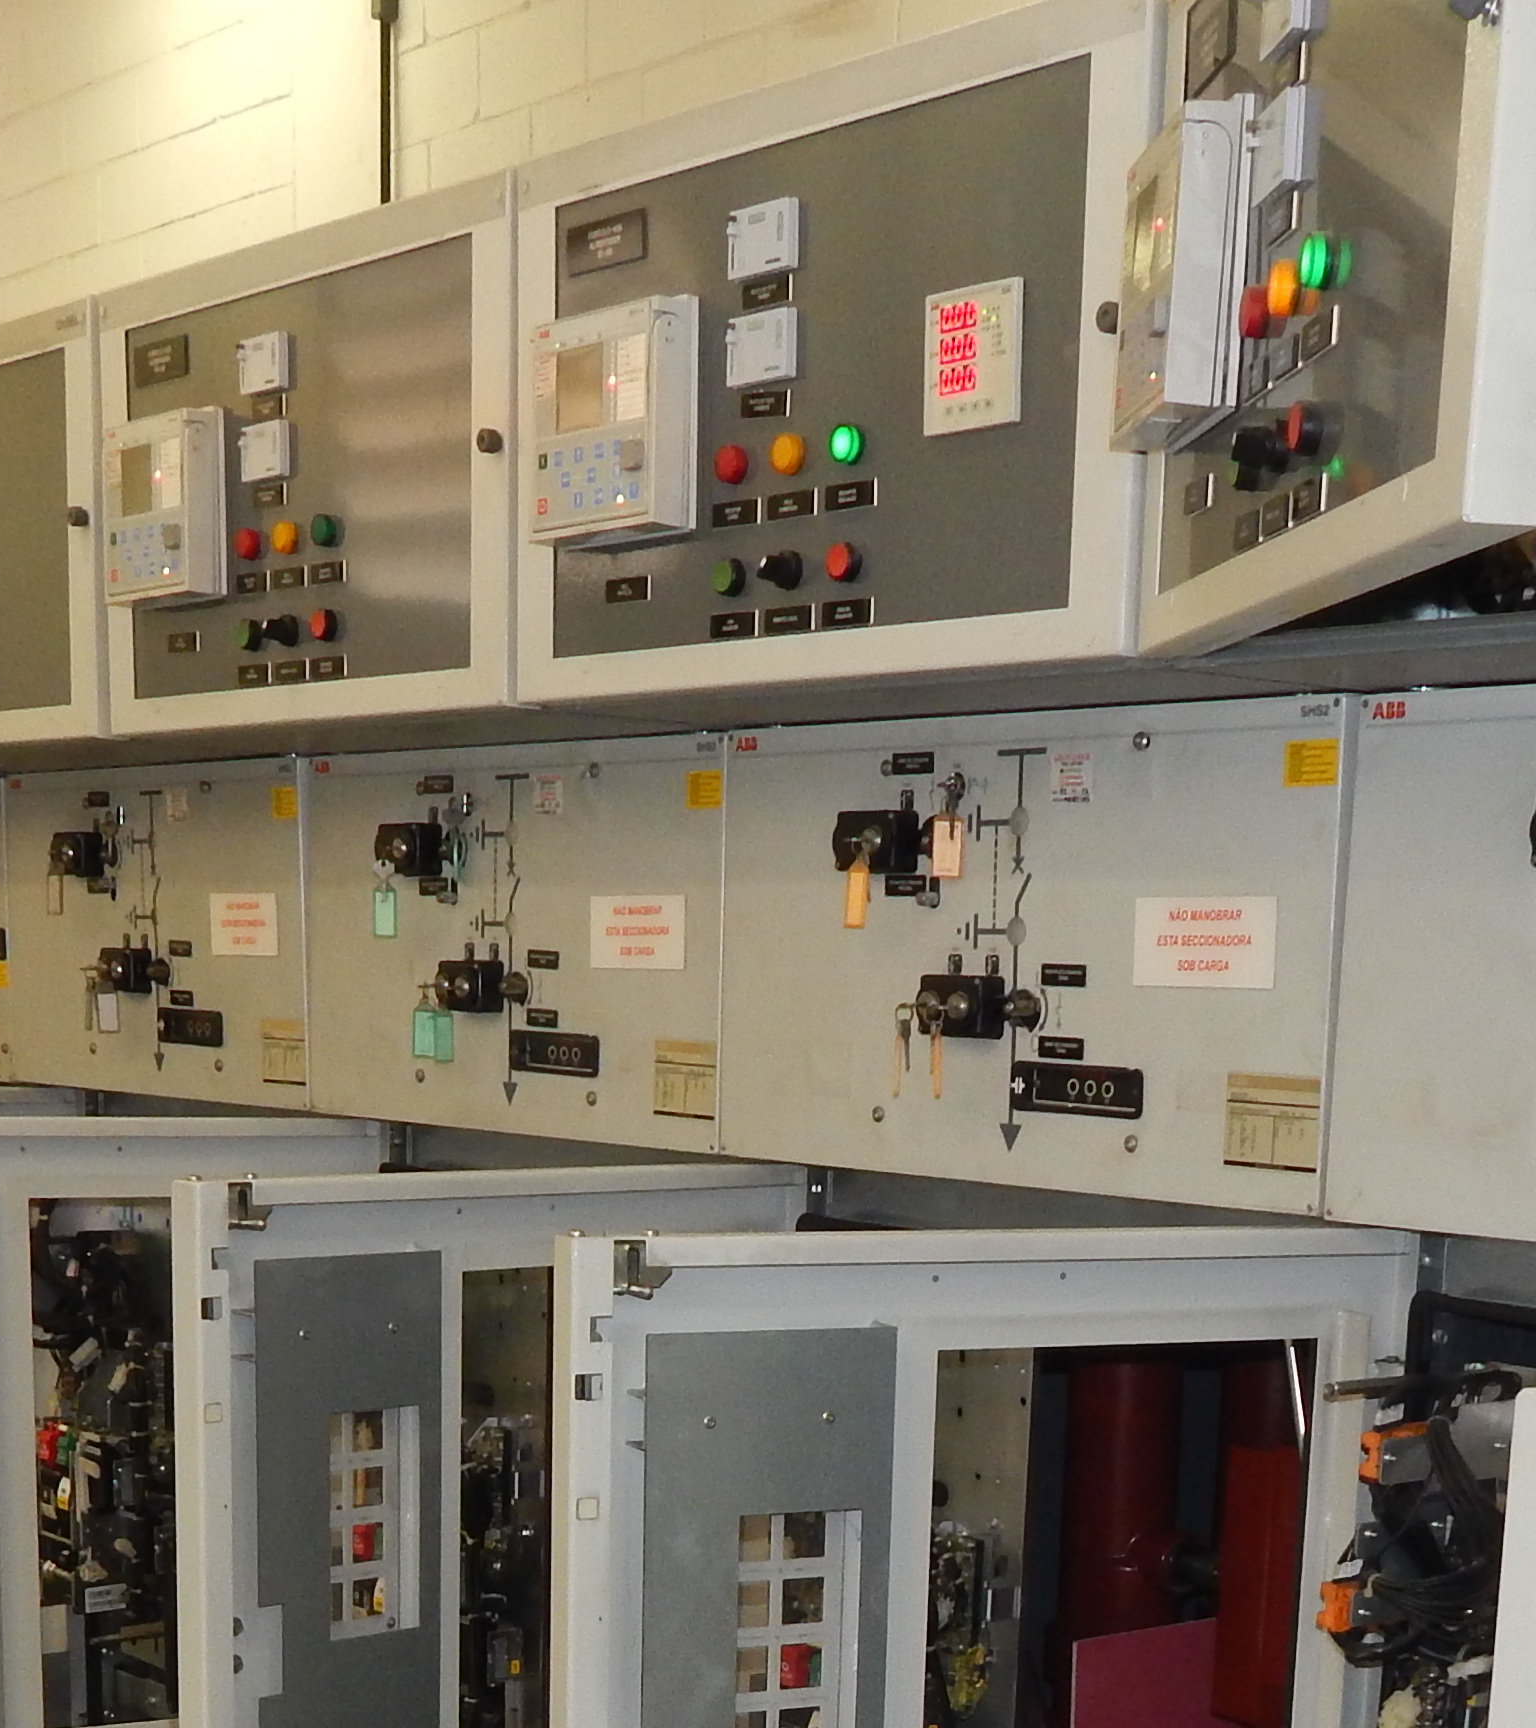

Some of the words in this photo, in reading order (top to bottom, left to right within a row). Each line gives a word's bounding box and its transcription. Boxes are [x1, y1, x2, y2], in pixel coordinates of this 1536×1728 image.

[1372, 701, 1406, 720] ABB
[1190, 908, 1242, 921] MANOBRAR
[1156, 934, 1178, 946] ESTA
[1180, 934, 1252, 946] SECCIONADORA
[1177, 960, 1196, 971] SOB
[1197, 960, 1229, 971] CARGA
